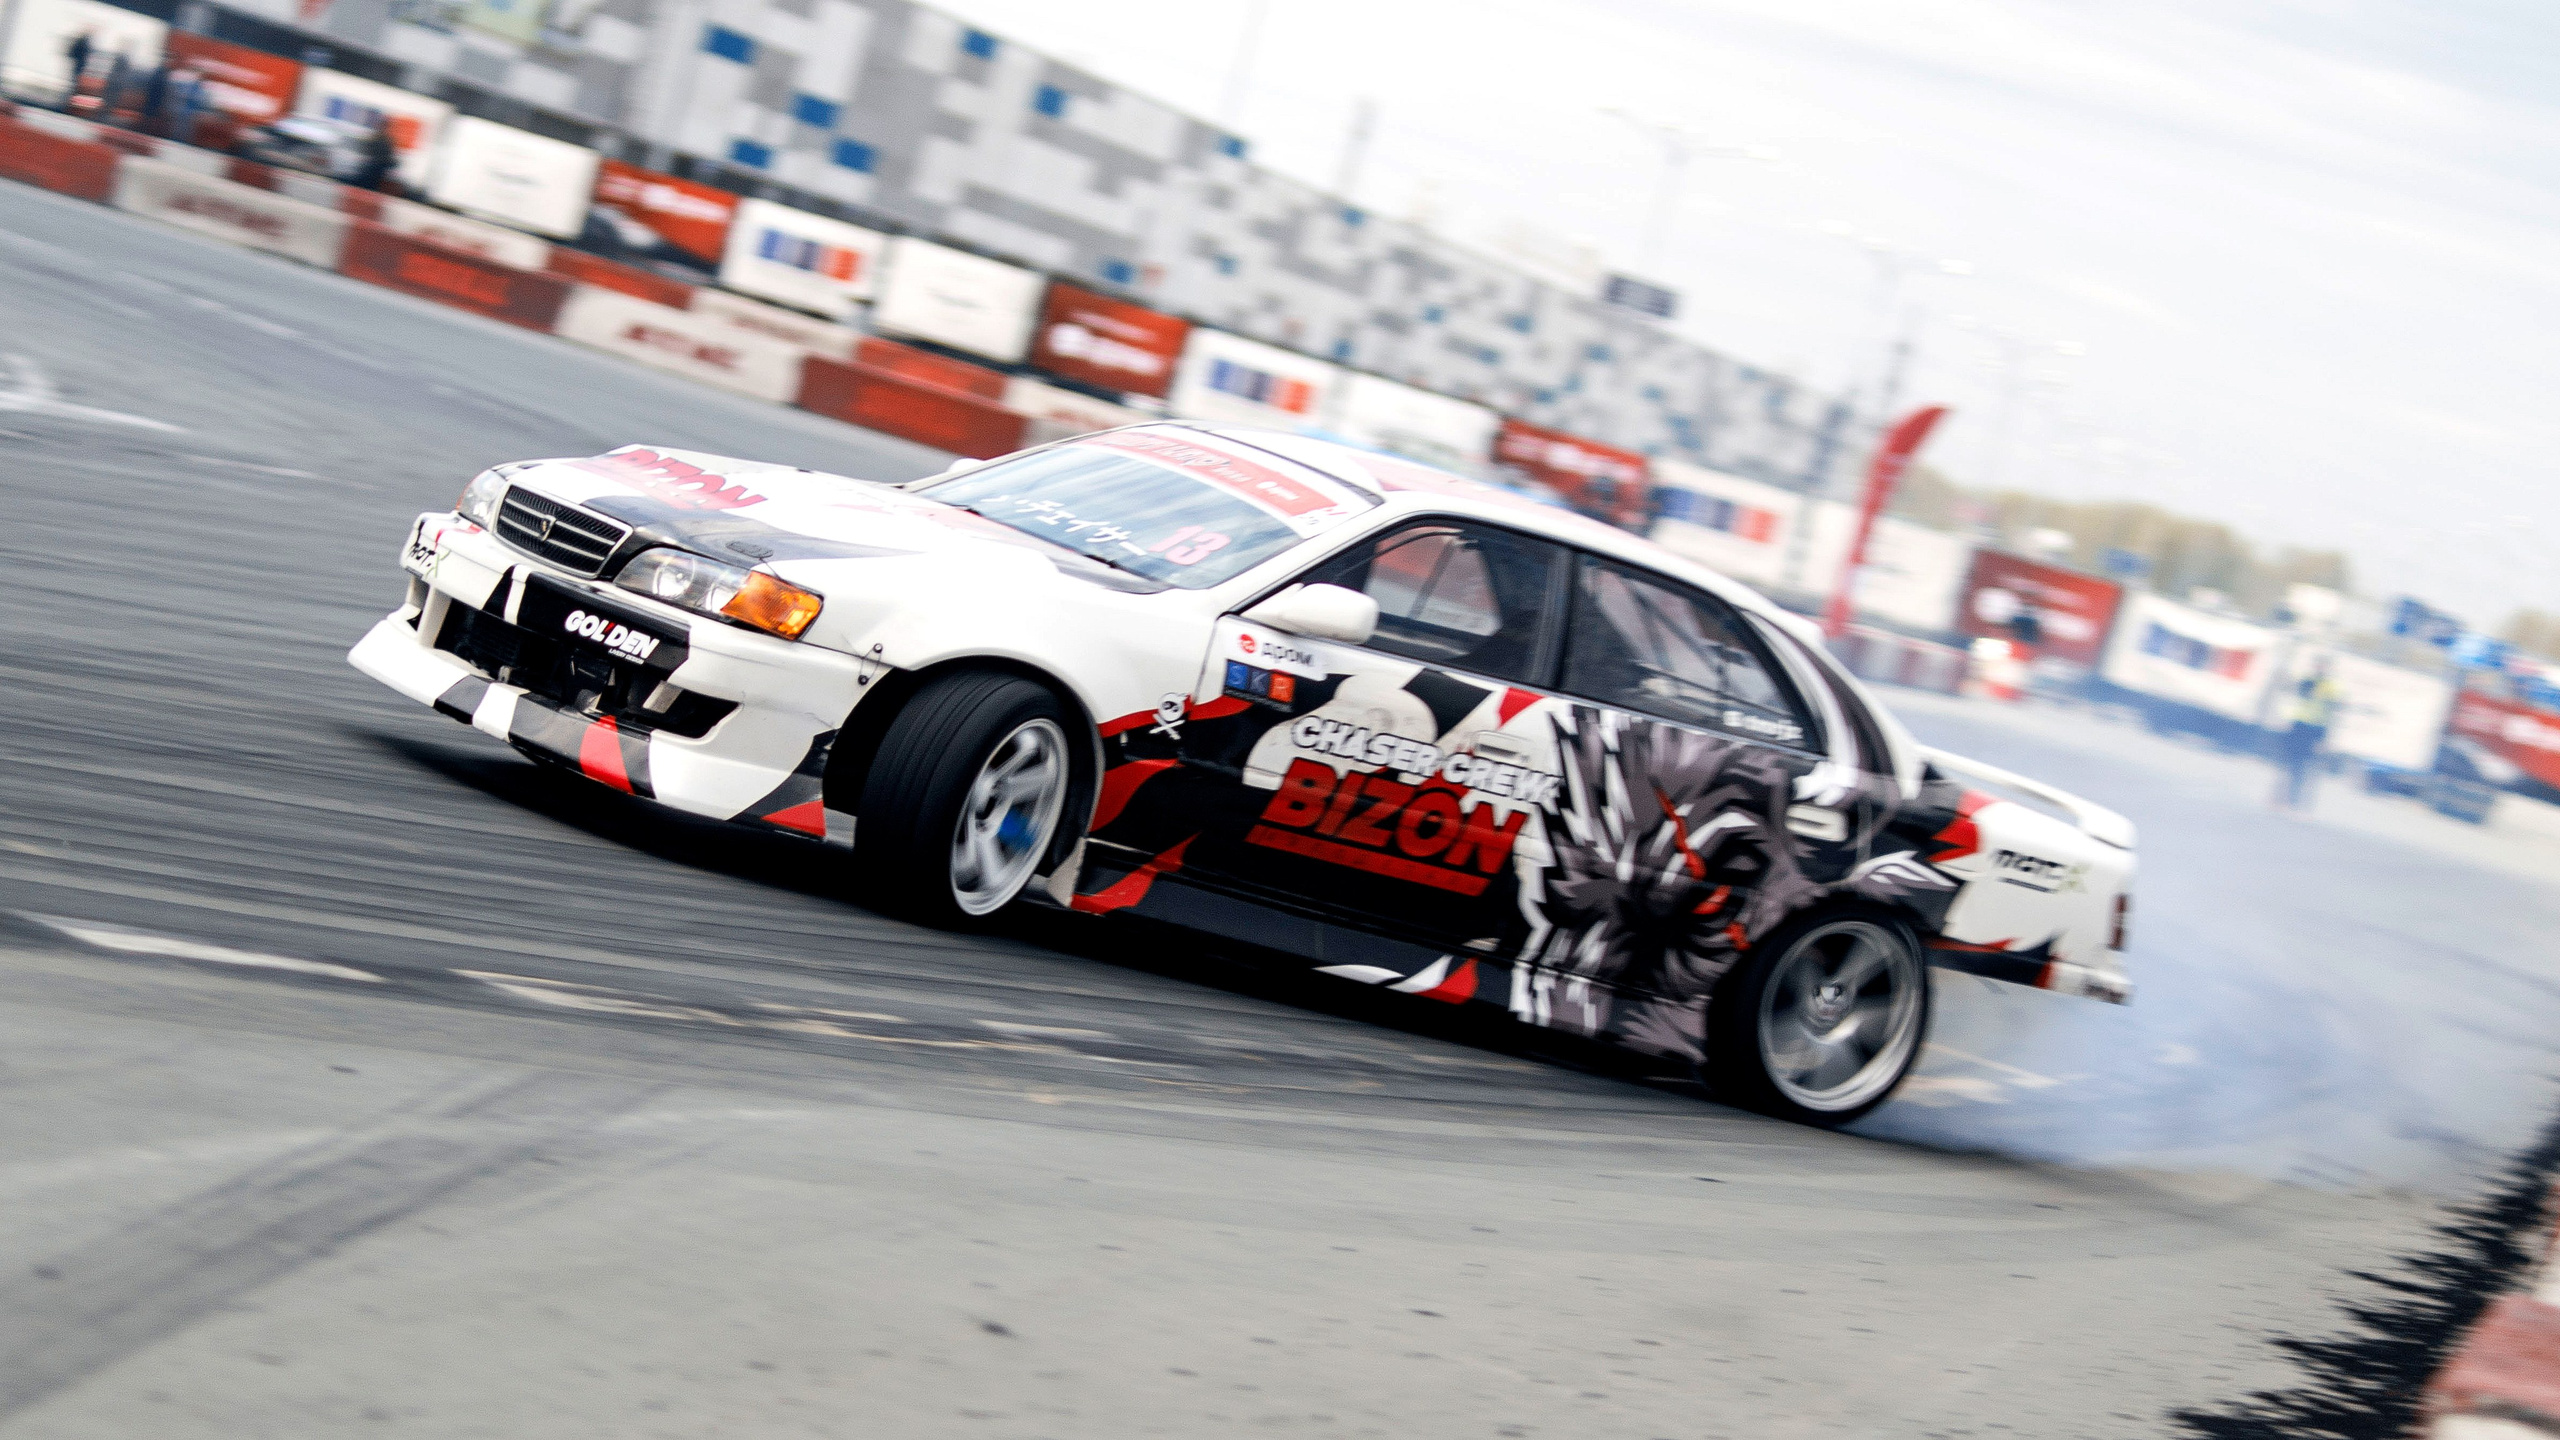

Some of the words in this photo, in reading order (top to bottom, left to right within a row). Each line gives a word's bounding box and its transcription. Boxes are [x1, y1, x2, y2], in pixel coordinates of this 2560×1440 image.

[1147, 525, 1232, 567] 13
[1292, 715, 1442, 777] CHASER
[1259, 757, 1529, 874] BIZON
